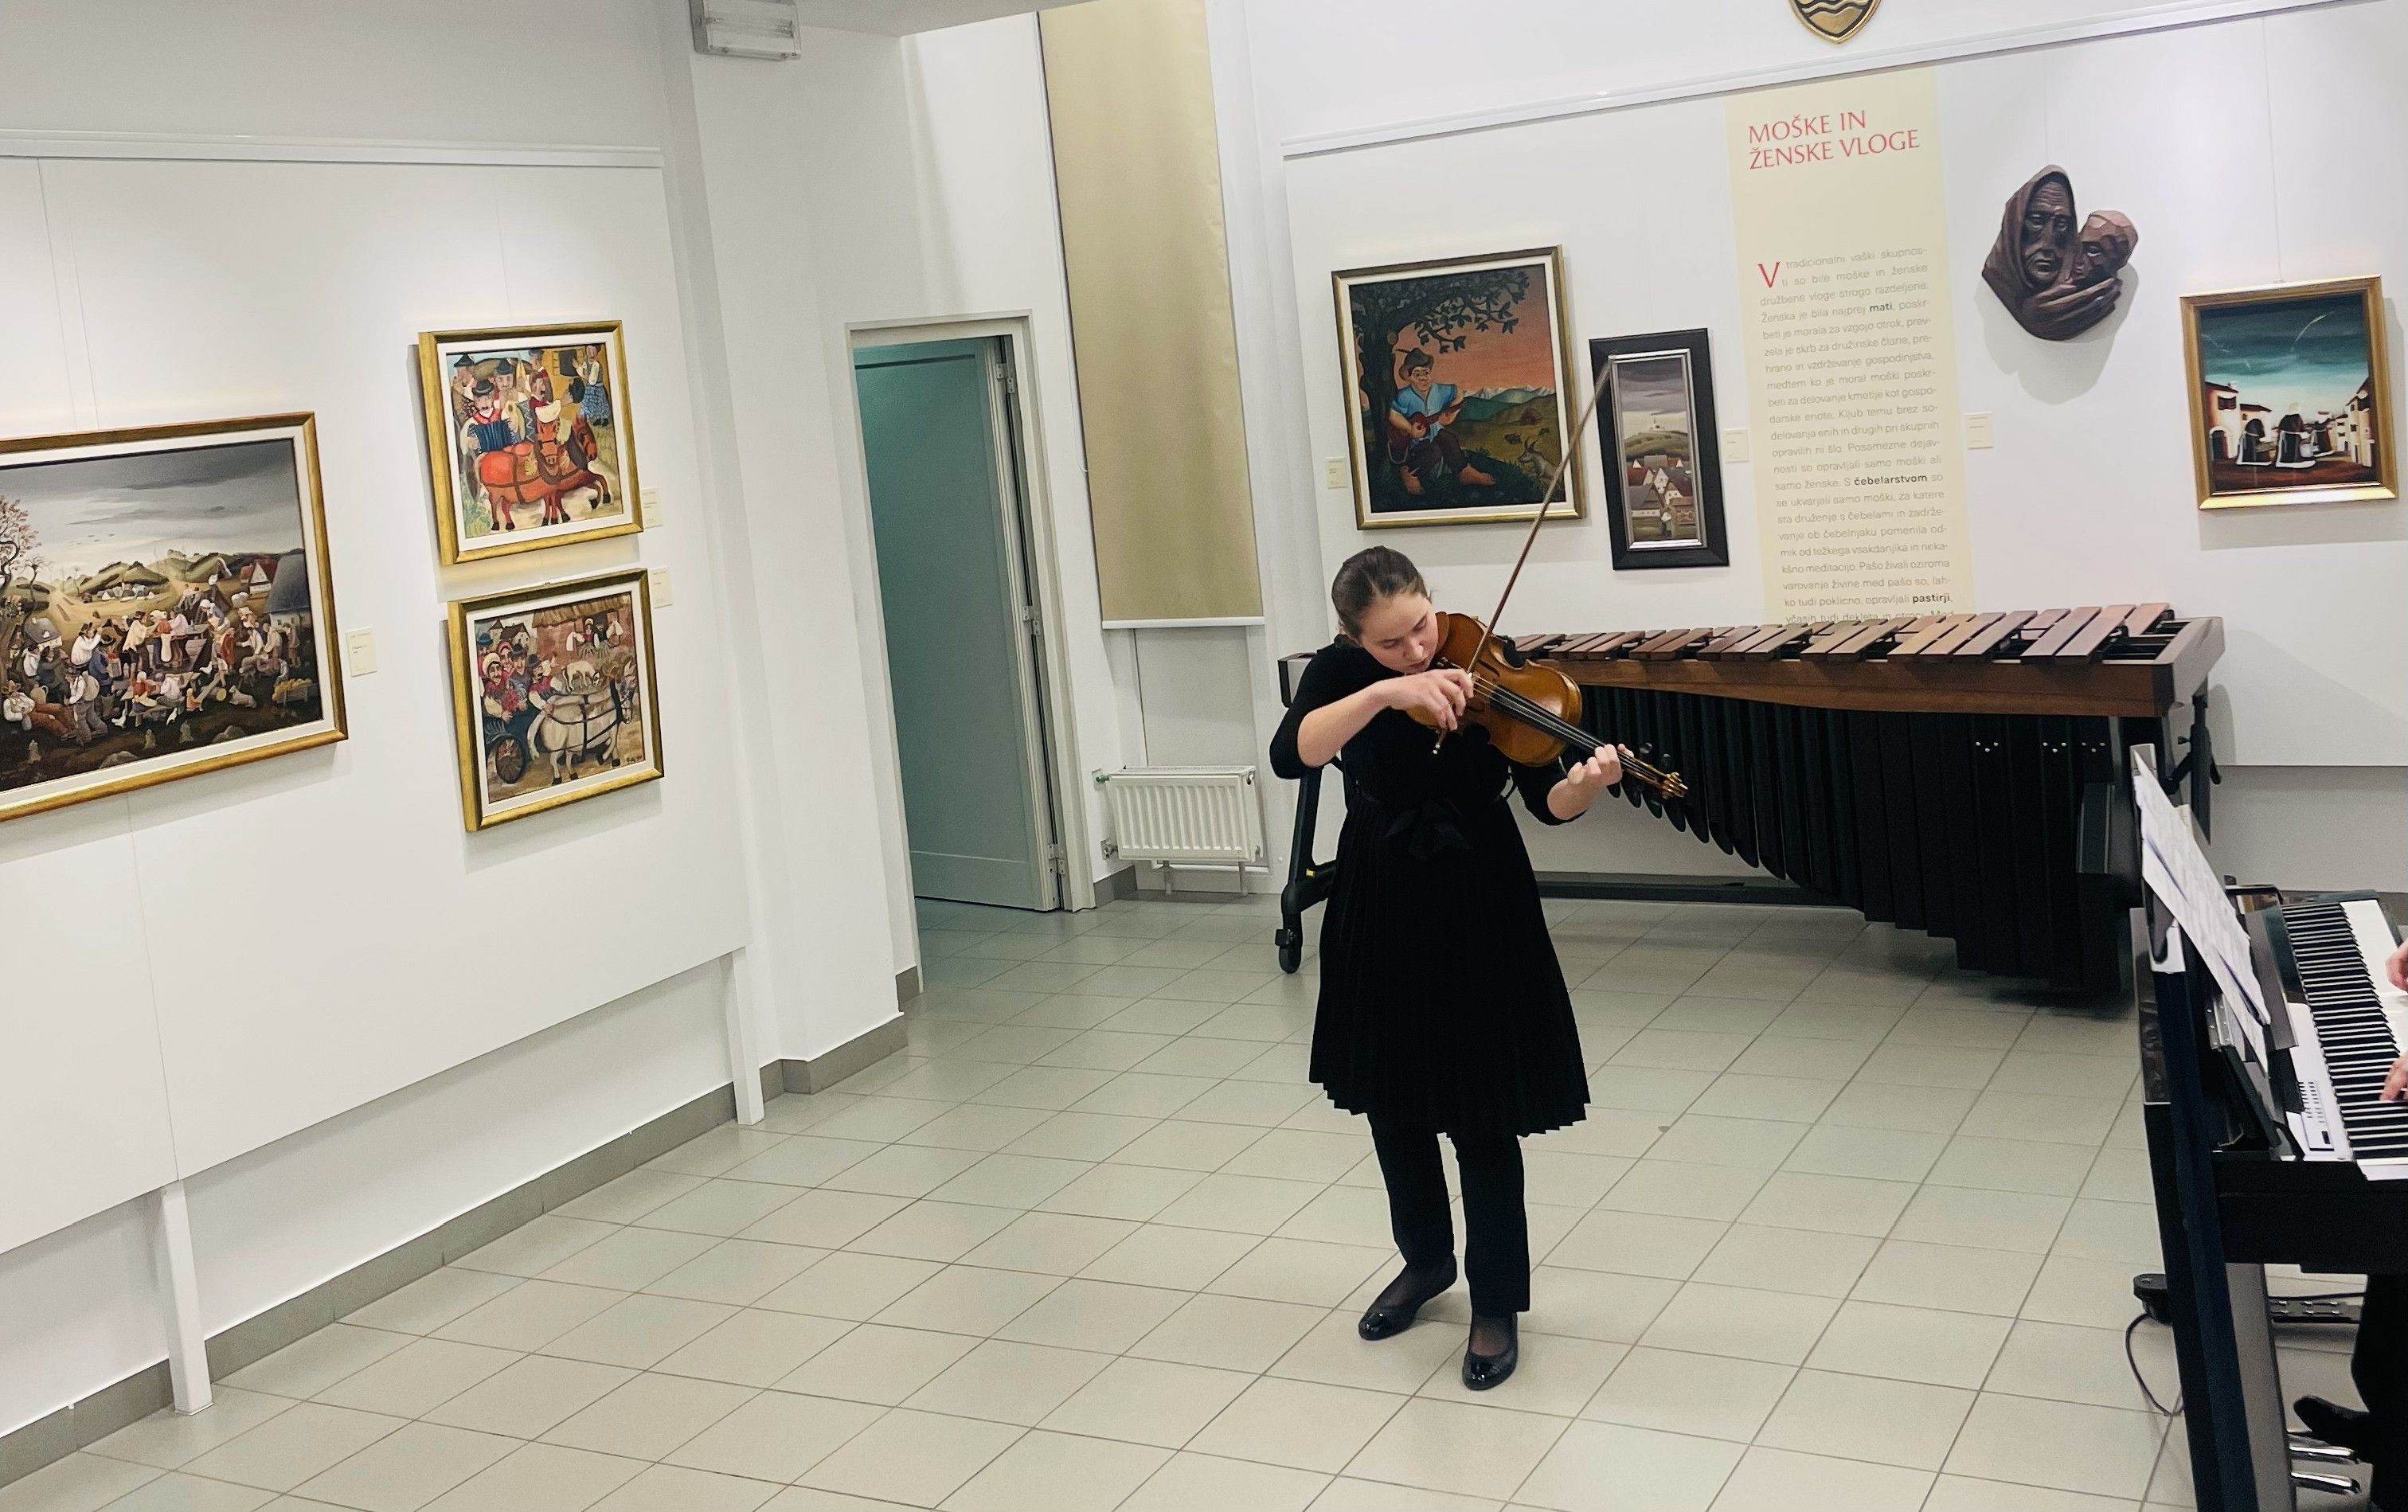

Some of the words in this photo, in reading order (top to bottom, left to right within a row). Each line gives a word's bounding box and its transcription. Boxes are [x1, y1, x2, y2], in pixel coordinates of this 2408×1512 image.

[1748, 114, 1831, 143] MOŠKE
[1840, 110, 1867, 131] IN
[1749, 141, 1834, 170] ŽENSKE
[1839, 130, 1920, 158] VLOGE
[1757, 261, 1781, 288] V
[1786, 255, 1846, 269] tradicionalni
[1851, 251, 1874, 262] vaški
[1881, 246, 1927, 259] skupnos-
[1836, 270, 1870, 281] moške
[1892, 264, 1928, 275] ženske
[1761, 293, 1806, 306] družbene
[1809, 291, 1835, 302] vloge
[1839, 287, 1870, 299] strogo
[1761, 312, 1796, 322] Ženska
[1799, 312, 1808, 321] je
[1811, 309, 1828, 318] bila
[1832, 306, 1866, 317] najprej
[1899, 299, 1930, 311] poskr-
[1794, 326, 1826, 337] morala
[1843, 323, 1874, 333] vzgojo
[1906, 318, 1931, 328] prev-
[1765, 348, 1783, 357] zela
[1784, 347, 1793, 356] je
[1796, 345, 1816, 354] skrb
[1831, 339, 1878, 351] družinske
[1913, 334, 1932, 344] pre-
[1765, 365, 1792, 373] hrano
[1808, 357, 1862, 370] vzdrževanje
[1767, 380, 1806, 390] medtem
[1825, 378, 1834, 387] je
[1839, 374, 1866, 385] moral
[1870, 371, 1899, 381] moški
[1904, 369, 1935, 380] poskr-
[1800, 393, 1846, 404] delovanje
[1848, 390, 1883, 401] kmetije
[1885, 389, 1900, 398] kot
[1902, 388, 1937, 400] gospo-
[1769, 414, 1800, 424] darske
[1867, 408, 1892, 416] temu
[1897, 405, 1917, 414] brez
[1771, 430, 1816, 440] delovanja
[1818, 428, 1839, 437] enih
[1851, 425, 1883, 436] drugih
[1900, 421, 1939, 432] skupnih
[1848, 441, 1906, 452] Posamezne
[1910, 440, 1941, 449] dejav-
[1774, 464, 1796, 474] nosti
[1817, 461, 1860, 472] opravljali
[1864, 459, 1892, 468] samo
[1897, 455, 1925, 466] moški
[1930, 455, 1941, 464] ali
[1775, 482, 1801, 490] samo
[1844, 478, 1851, 486] S
[1854, 474, 1928, 485] čebelarstvom
[1791, 496, 1830, 507] ukvarjali
[1834, 495, 1861, 504] samo
[1914, 490, 1945, 499] katere
[1795, 512, 1837, 523] druženje
[1848, 510, 1893, 520] čebelami
[1908, 507, 1945, 518] zadrže-
[1779, 531, 1804, 541] vanje
[1808, 530, 1820, 539] ob
[1824, 528, 1877, 539] čebelnjaku
[1881, 525, 1927, 537] pomenila
[1931, 525, 1947, 533] od-
[1781, 548, 1796, 557] mik
[1813, 545, 1850, 556] težkega
[1852, 543, 1908, 554] vsakdanjika
[1859, 561, 1883, 570] Pašo
[1885, 561, 1908, 569] živali
[1910, 559, 1949, 568] oziroma
[1784, 581, 1829, 590] varovanje
[1832, 579, 1860, 588] živine
[1863, 578, 1885, 587] med
[1888, 577, 1912, 587] pašo
[1932, 576, 1951, 584] lah-
[1785, 598, 1796, 607] ko
[1798, 597, 1816, 606] tudi
[1866, 593, 1910, 604] opravljali
